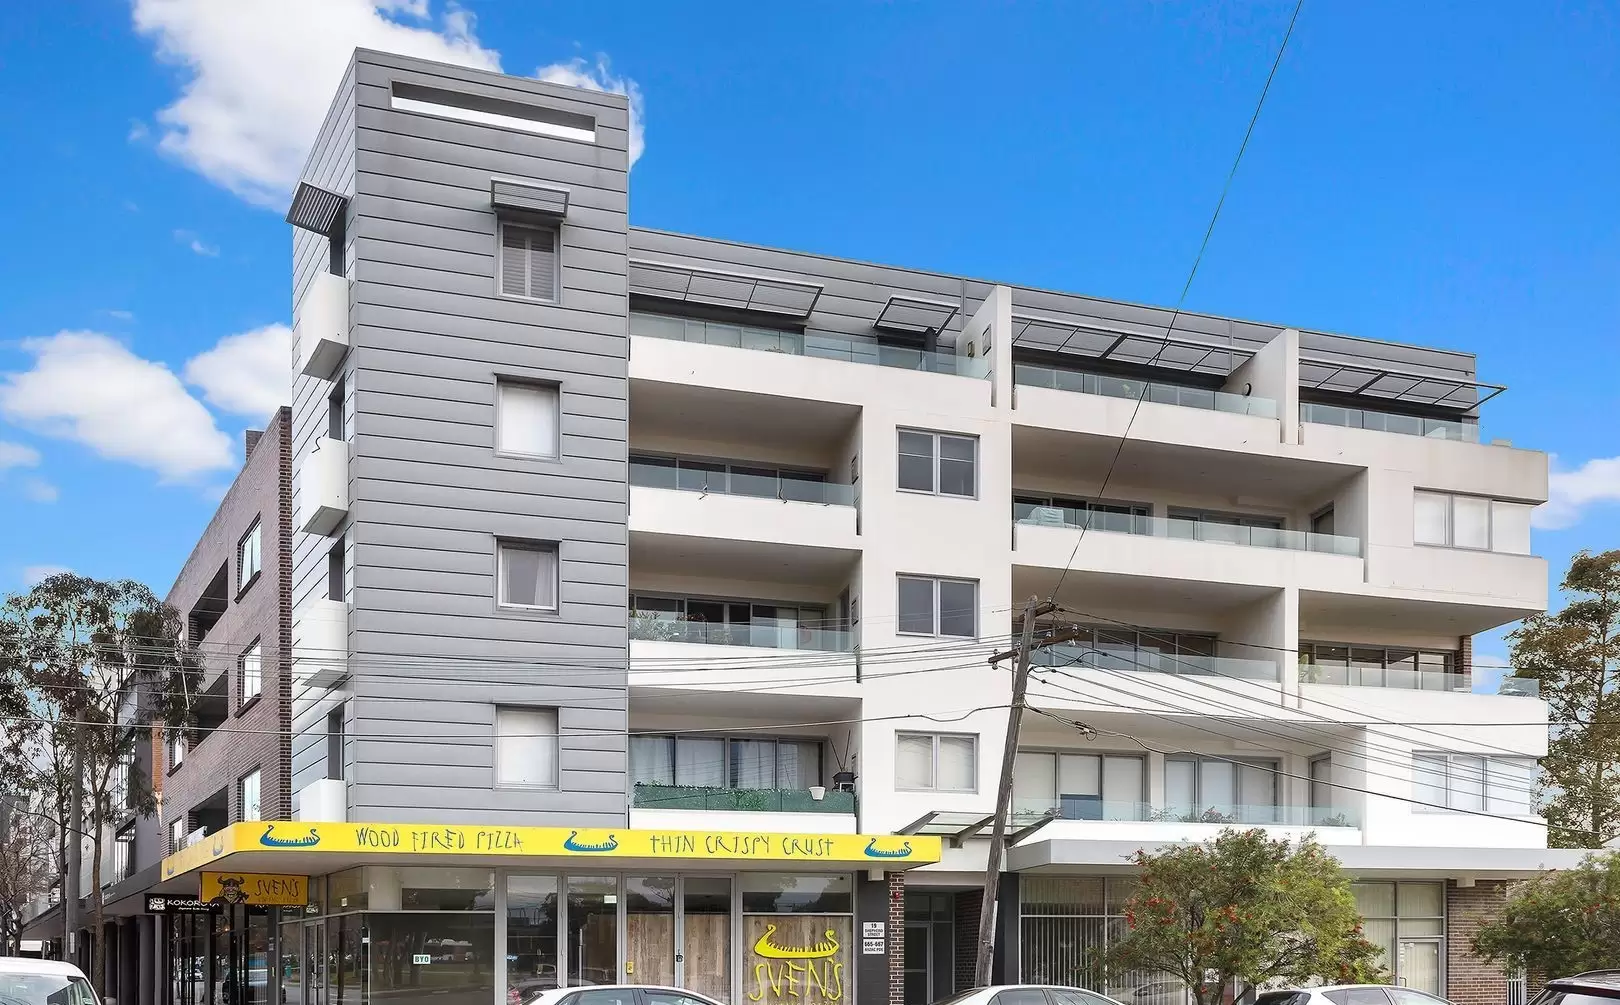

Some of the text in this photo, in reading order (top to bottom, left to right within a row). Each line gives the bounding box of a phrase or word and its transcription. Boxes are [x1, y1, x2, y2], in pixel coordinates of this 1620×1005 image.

[356, 827, 525, 852] WOOD FIRED PIZZA
[650, 835, 835, 856] THIN CRISPY CRUST
[254, 878, 300, 897] SVEN'S
[748, 957, 843, 1001] SVEN'S
